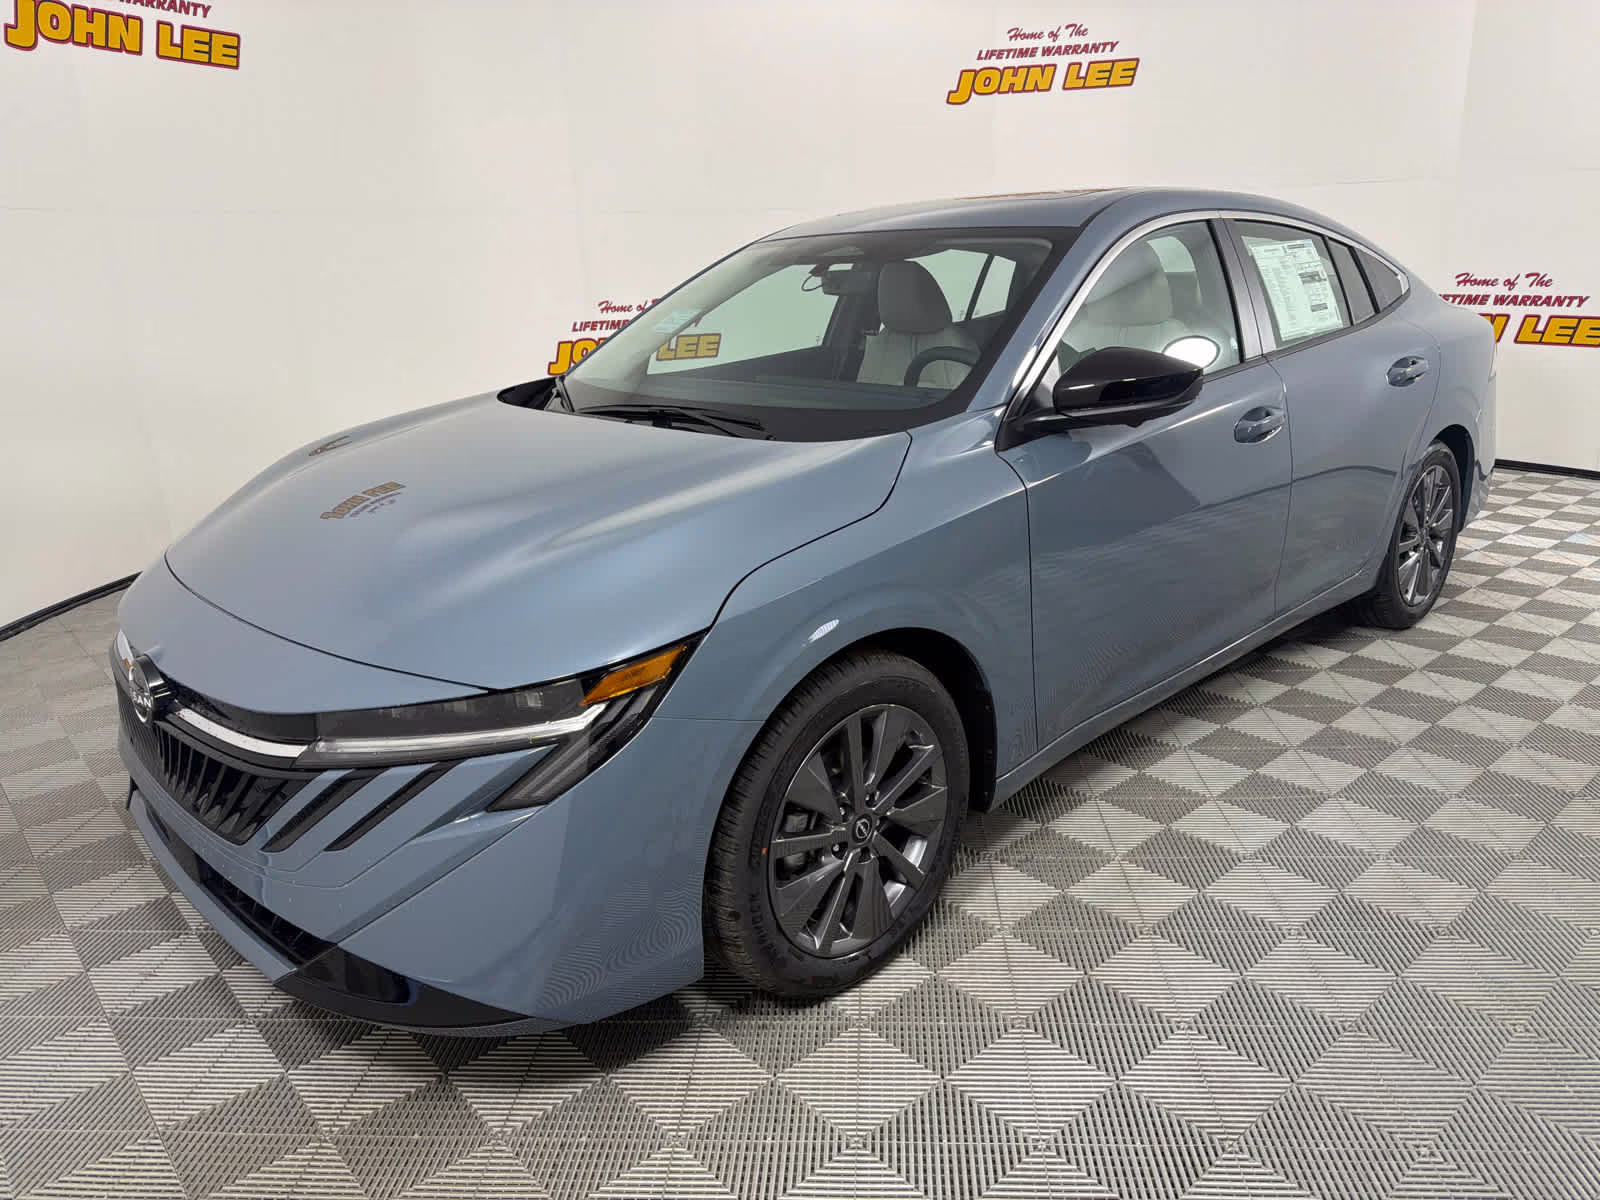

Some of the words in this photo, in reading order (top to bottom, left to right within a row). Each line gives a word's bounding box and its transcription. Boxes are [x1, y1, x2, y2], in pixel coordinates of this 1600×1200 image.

[118, 0, 211, 18] RRANTY
[4, 0, 143, 56] JOHN
[156, 20, 241, 70] LEE
[1007, 27, 1044, 42] Home
[1048, 26, 1061, 42] of
[1065, 23, 1088, 38] The
[976, 46, 1039, 61] LIFETIME
[1041, 41, 1119, 57] WARRANTY
[946, 63, 1057, 105] JOHN
[1062, 57, 1140, 91] LEE
[1455, 272, 1499, 287] Home
[1503, 273, 1520, 291] of
[1525, 272, 1553, 288] The
[598, 300, 633, 314] Home
[1492, 294, 1591, 308] WARRANTY
[1514, 313, 1600, 348] LEE
[547, 337, 608, 376] JO
